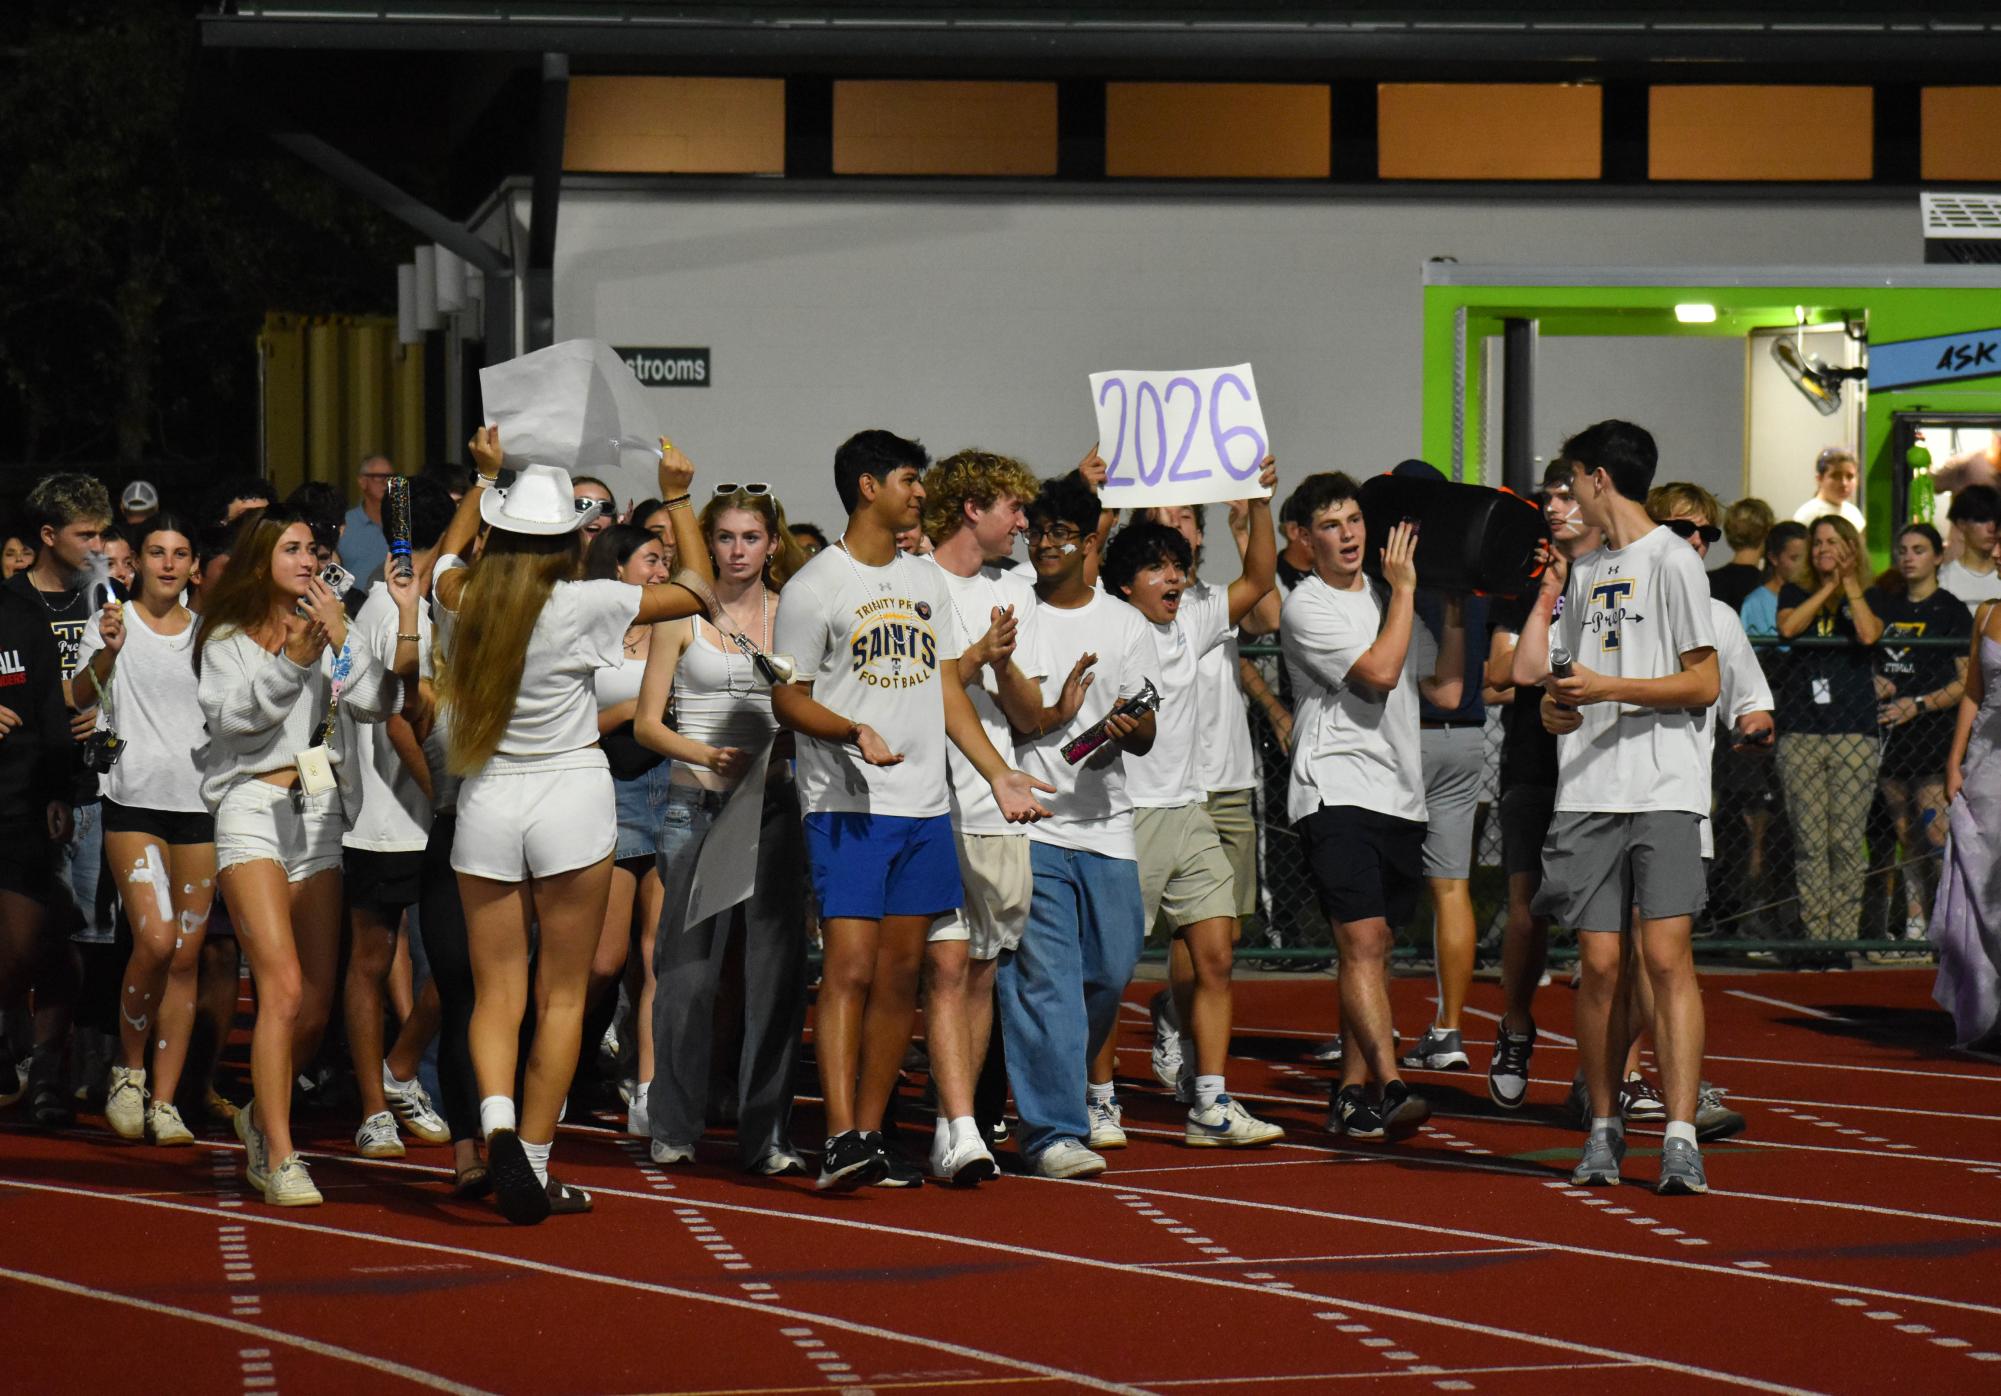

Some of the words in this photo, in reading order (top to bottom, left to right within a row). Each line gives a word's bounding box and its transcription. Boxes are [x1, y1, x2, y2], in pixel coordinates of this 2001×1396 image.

[625, 354, 705, 380] strooms
[1936, 341, 1998, 371] ASK
[1100, 373, 1266, 487] 2026
[855, 598, 895, 619] TRINITY
[58, 640, 80, 654] Pre
[852, 622, 936, 672] SAINTS
[859, 669, 930, 689] FOOTBALL
